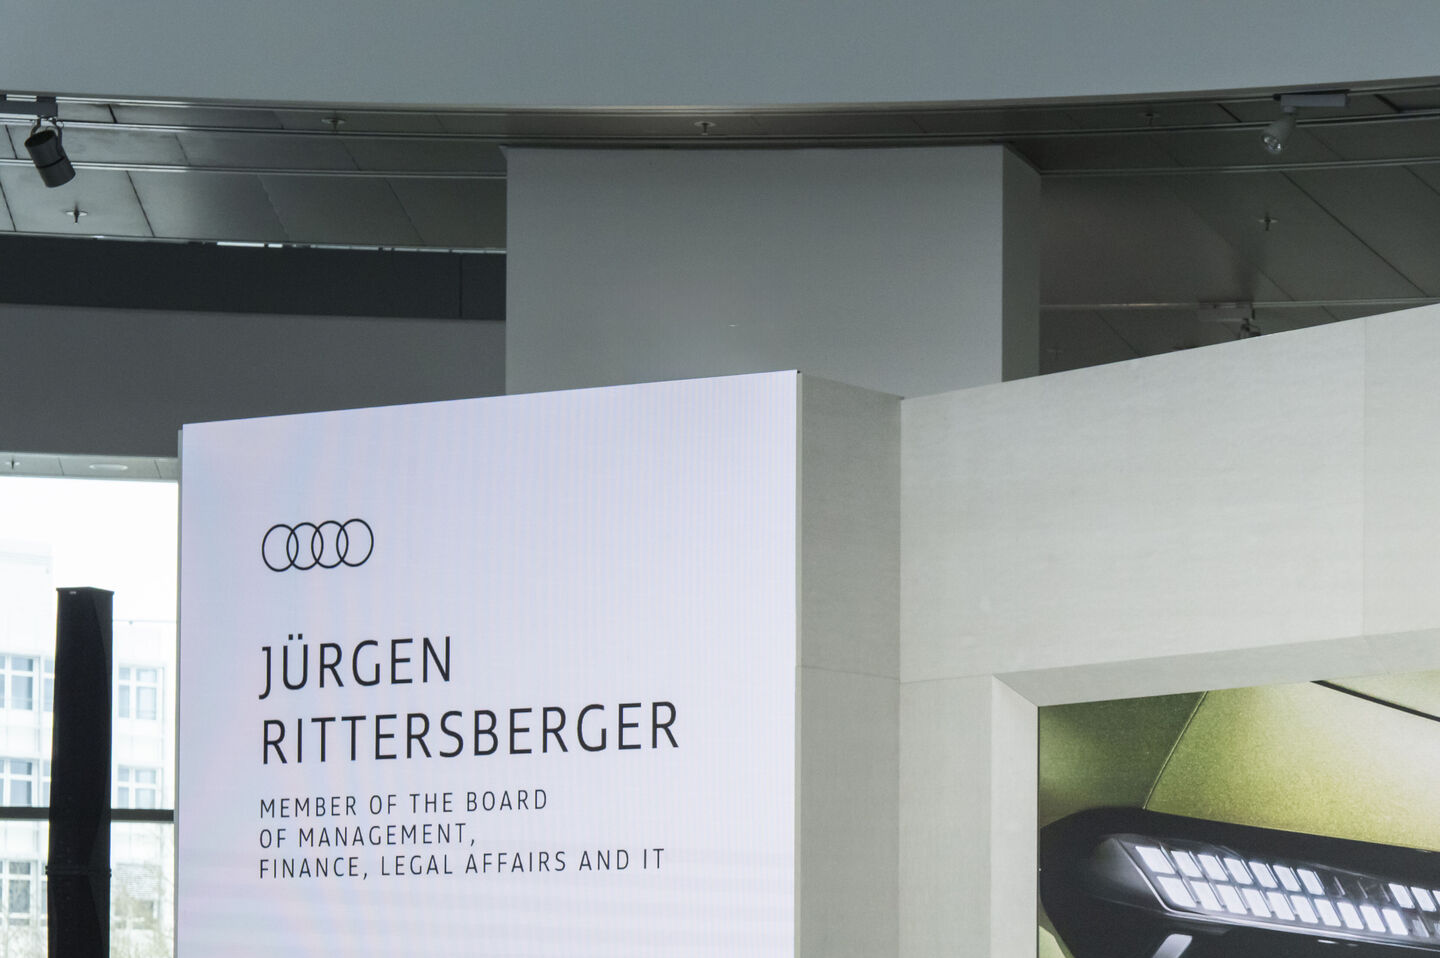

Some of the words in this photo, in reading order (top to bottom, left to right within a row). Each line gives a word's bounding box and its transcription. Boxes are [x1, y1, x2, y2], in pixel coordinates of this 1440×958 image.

[258, 633, 451, 700] JÜRGEN
[262, 701, 680, 765] RITTERSBERGER
[260, 795, 357, 819] MEMBER
[369, 794, 397, 815] OF
[409, 792, 453, 814] THE
[466, 789, 547, 812] BOARD
[259, 828, 287, 849] OF
[299, 823, 475, 848] MANAGEMENT,
[259, 856, 368, 881] FINANCE,
[381, 853, 453, 876] LEGAL
[464, 850, 566, 874] AFFAIRS
[578, 849, 629, 871] AND
[643, 847, 665, 870] IT
